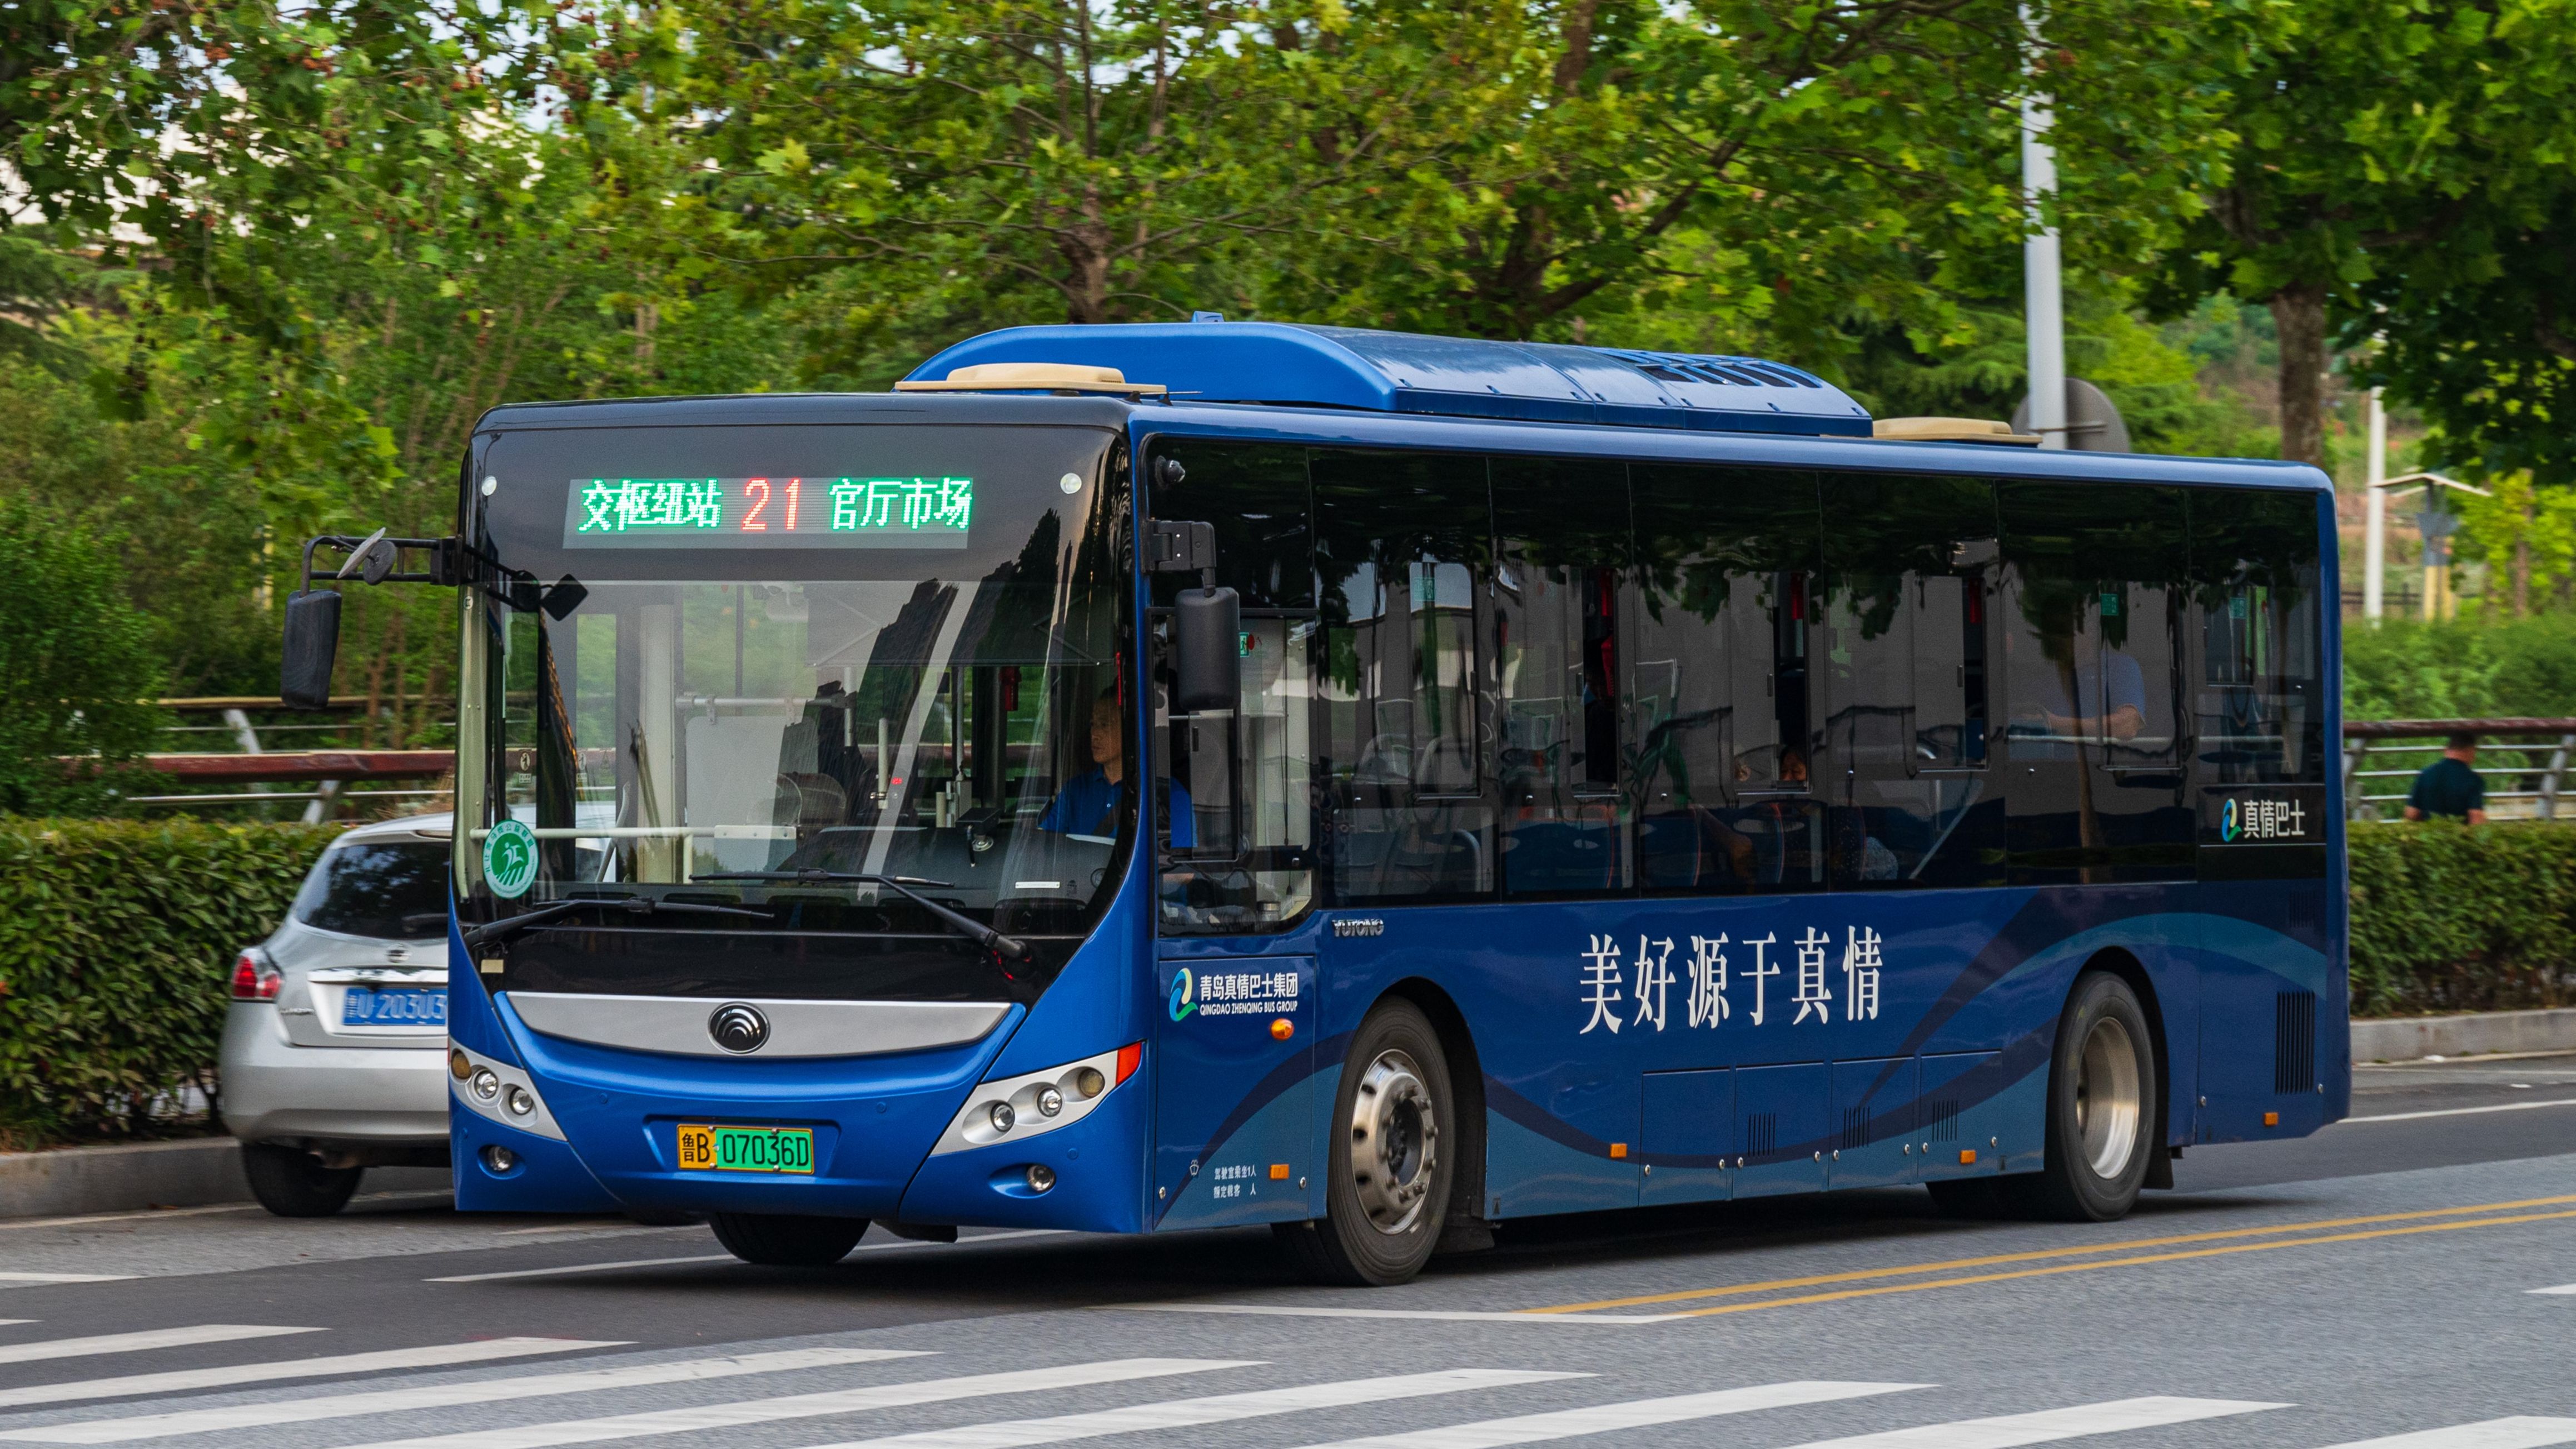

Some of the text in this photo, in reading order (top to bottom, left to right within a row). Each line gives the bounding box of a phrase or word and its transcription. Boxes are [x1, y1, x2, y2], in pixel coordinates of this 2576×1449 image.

[579, 477, 973, 531] 交枢纽站 21 官厅市场
[2244, 799, 2305, 839] 真情巴士
[1332, 919, 1384, 937] YUTONG
[1200, 972, 1298, 1001] 青岛真情巴士集团
[1580, 925, 1883, 1034] 美好源于真情
[1200, 1000, 1298, 1016] QINGDAO ZHENQING BUS GROUP
